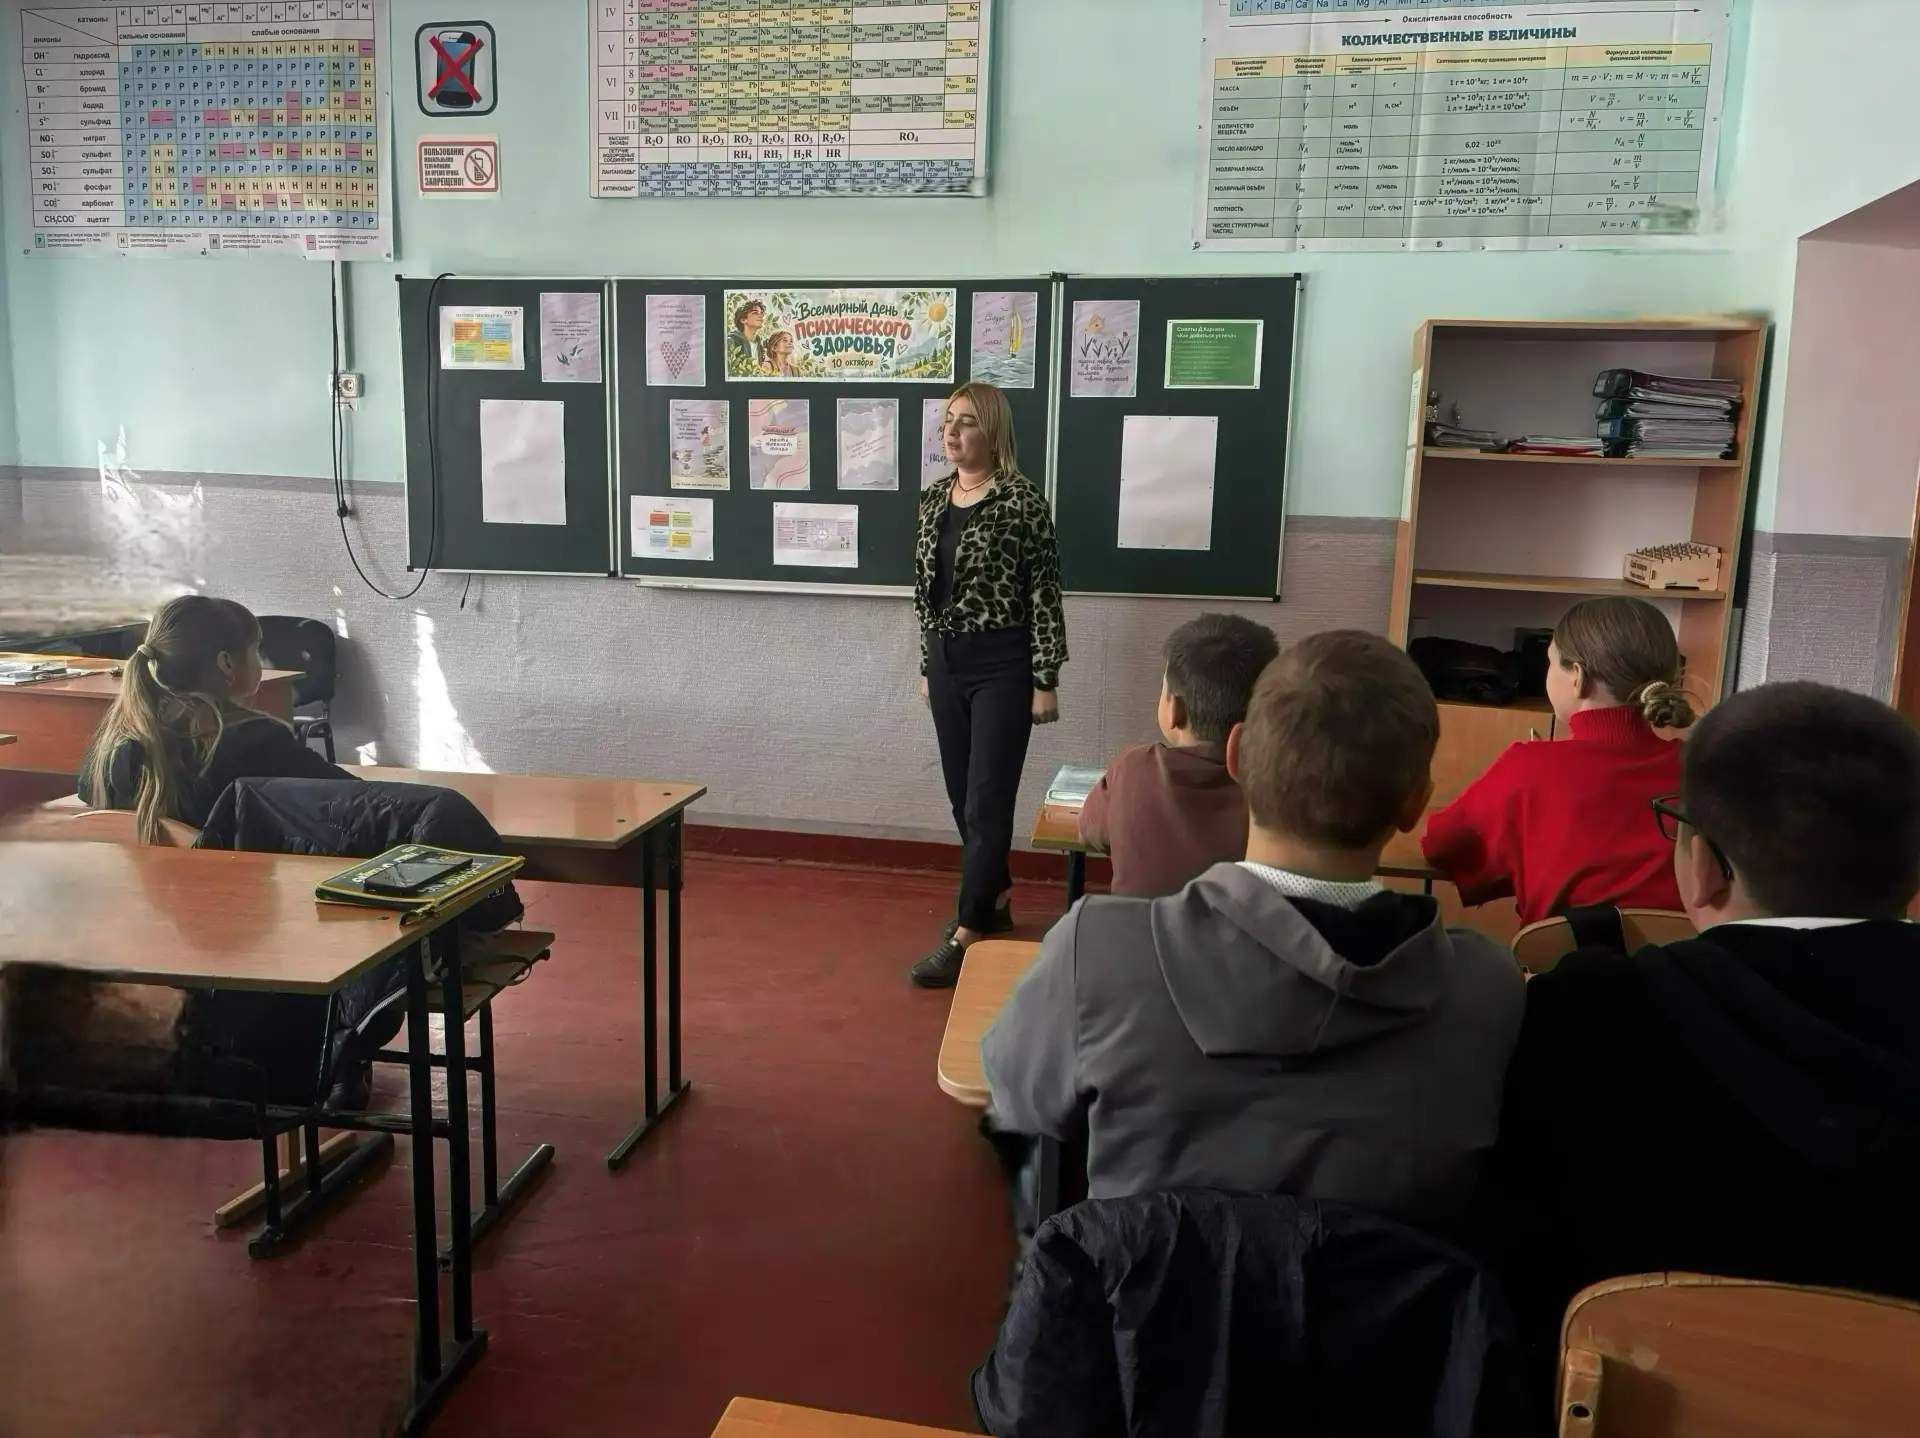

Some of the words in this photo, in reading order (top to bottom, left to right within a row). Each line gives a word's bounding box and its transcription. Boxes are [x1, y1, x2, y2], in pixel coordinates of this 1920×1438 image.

[606, 8, 616, 18] IV
[628, 18, 634, 26] 5
[1402, 14, 1462, 23] Окислительная
[1464, 13, 1513, 22] способность
[251, 27, 280, 36] слабые
[628, 35, 634, 44] 6
[1342, 30, 1484, 46] КОЛИЧЕСТВЕННЫЕ
[1488, 27, 1577, 42] ВЕЛИЧИНЫ
[608, 44, 615, 53] V
[640, 49, 650, 57] Ag
[628, 52, 634, 61] 7
[628, 70, 634, 78] 8
[606, 78, 616, 87] VI
[628, 86, 634, 96] 9
[82, 101, 104, 110] йодид
[627, 104, 636, 113] 10
[604, 112, 618, 121] VII
[80, 118, 111, 126] сульфид
[627, 120, 636, 130] 11
[82, 135, 106, 143] нитрат
[676, 135, 690, 144] RO
[82, 150, 112, 159] сульфит
[424, 148, 464, 156] ПОЛЬЗОВАНИЕ
[826, 148, 841, 158] HR
[82, 166, 112, 175] сульфат
[425, 178, 464, 187] ЗАПРЕЩЕНО!
[84, 183, 112, 192] фосфат
[82, 199, 114, 208] карбонат
[798, 300, 868, 321] Всемирный
[870, 301, 898, 318] День
[794, 317, 912, 341] ПСИХИЧЕСКОГО
[811, 336, 896, 358] ЗДОРОВЬЯ
[832, 358, 842, 368] 10
[844, 358, 874, 368] октября
